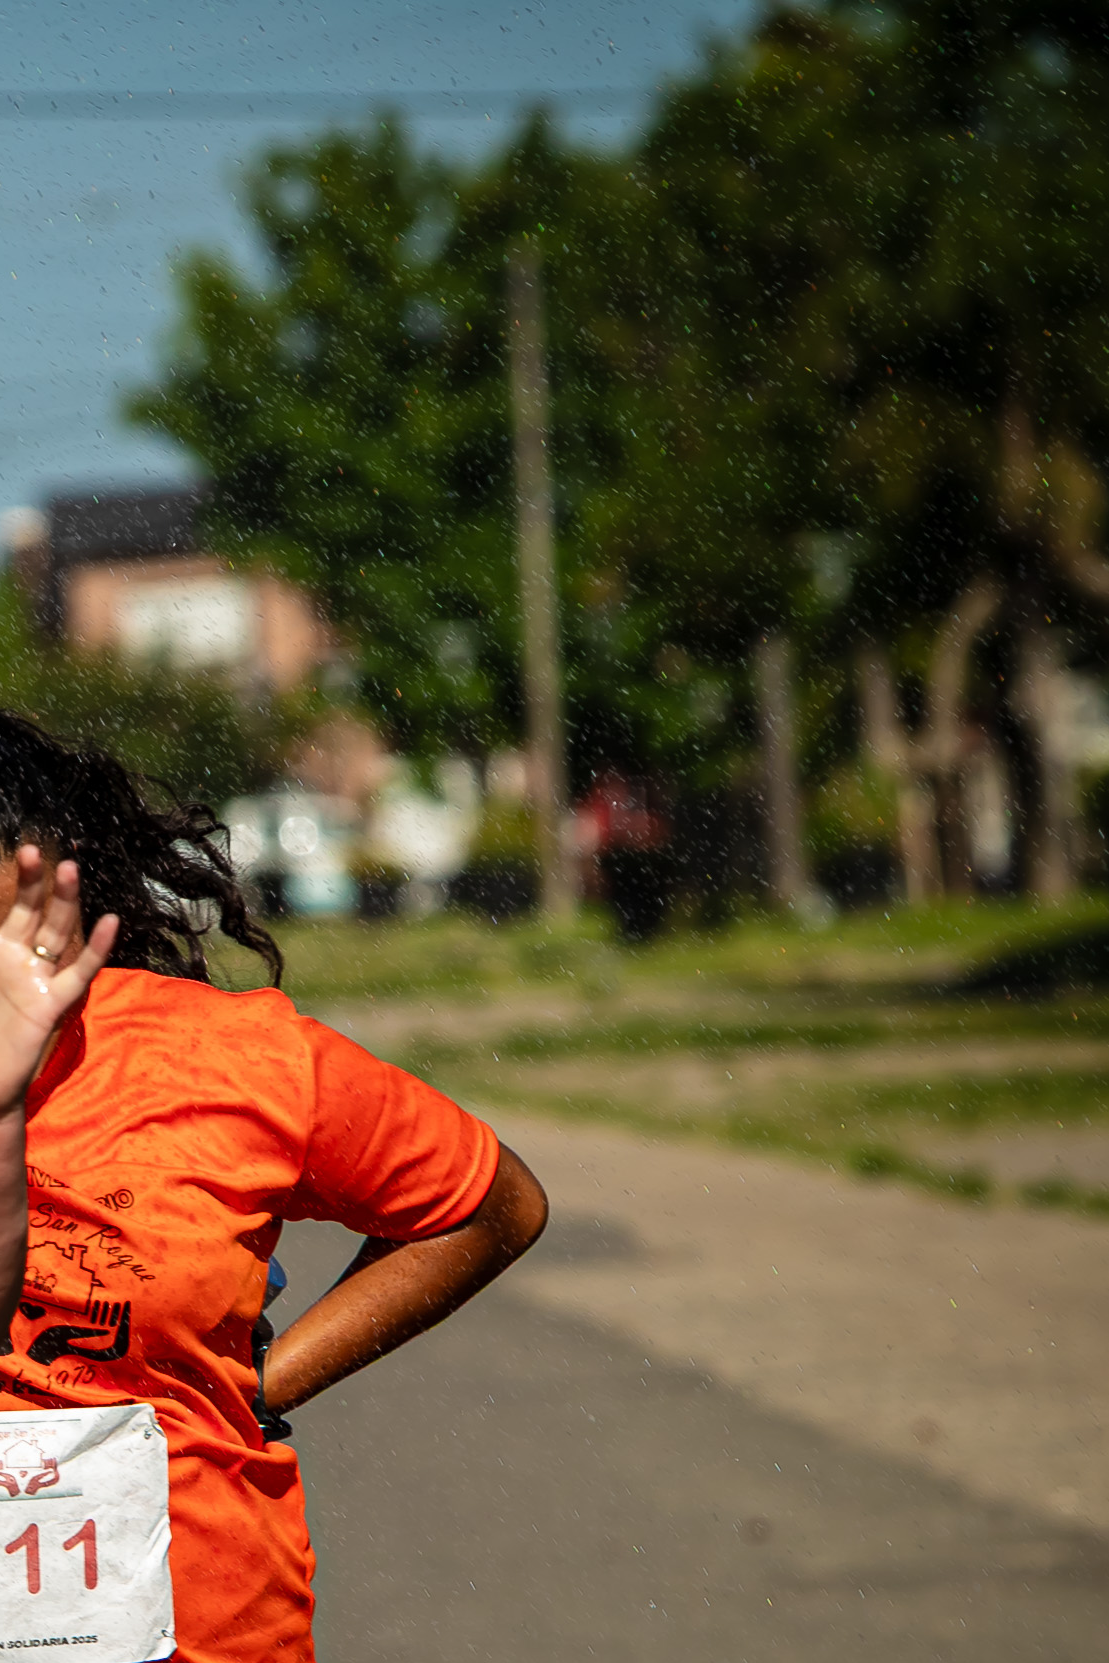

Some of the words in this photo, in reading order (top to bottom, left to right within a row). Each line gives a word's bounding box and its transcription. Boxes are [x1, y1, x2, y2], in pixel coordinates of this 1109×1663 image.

[29, 1202, 78, 1234] San
[84, 1223, 156, 1282] Roque
[6, 1636, 69, 1650] SOLIDARIA
[71, 1634, 99, 1645] 2025
